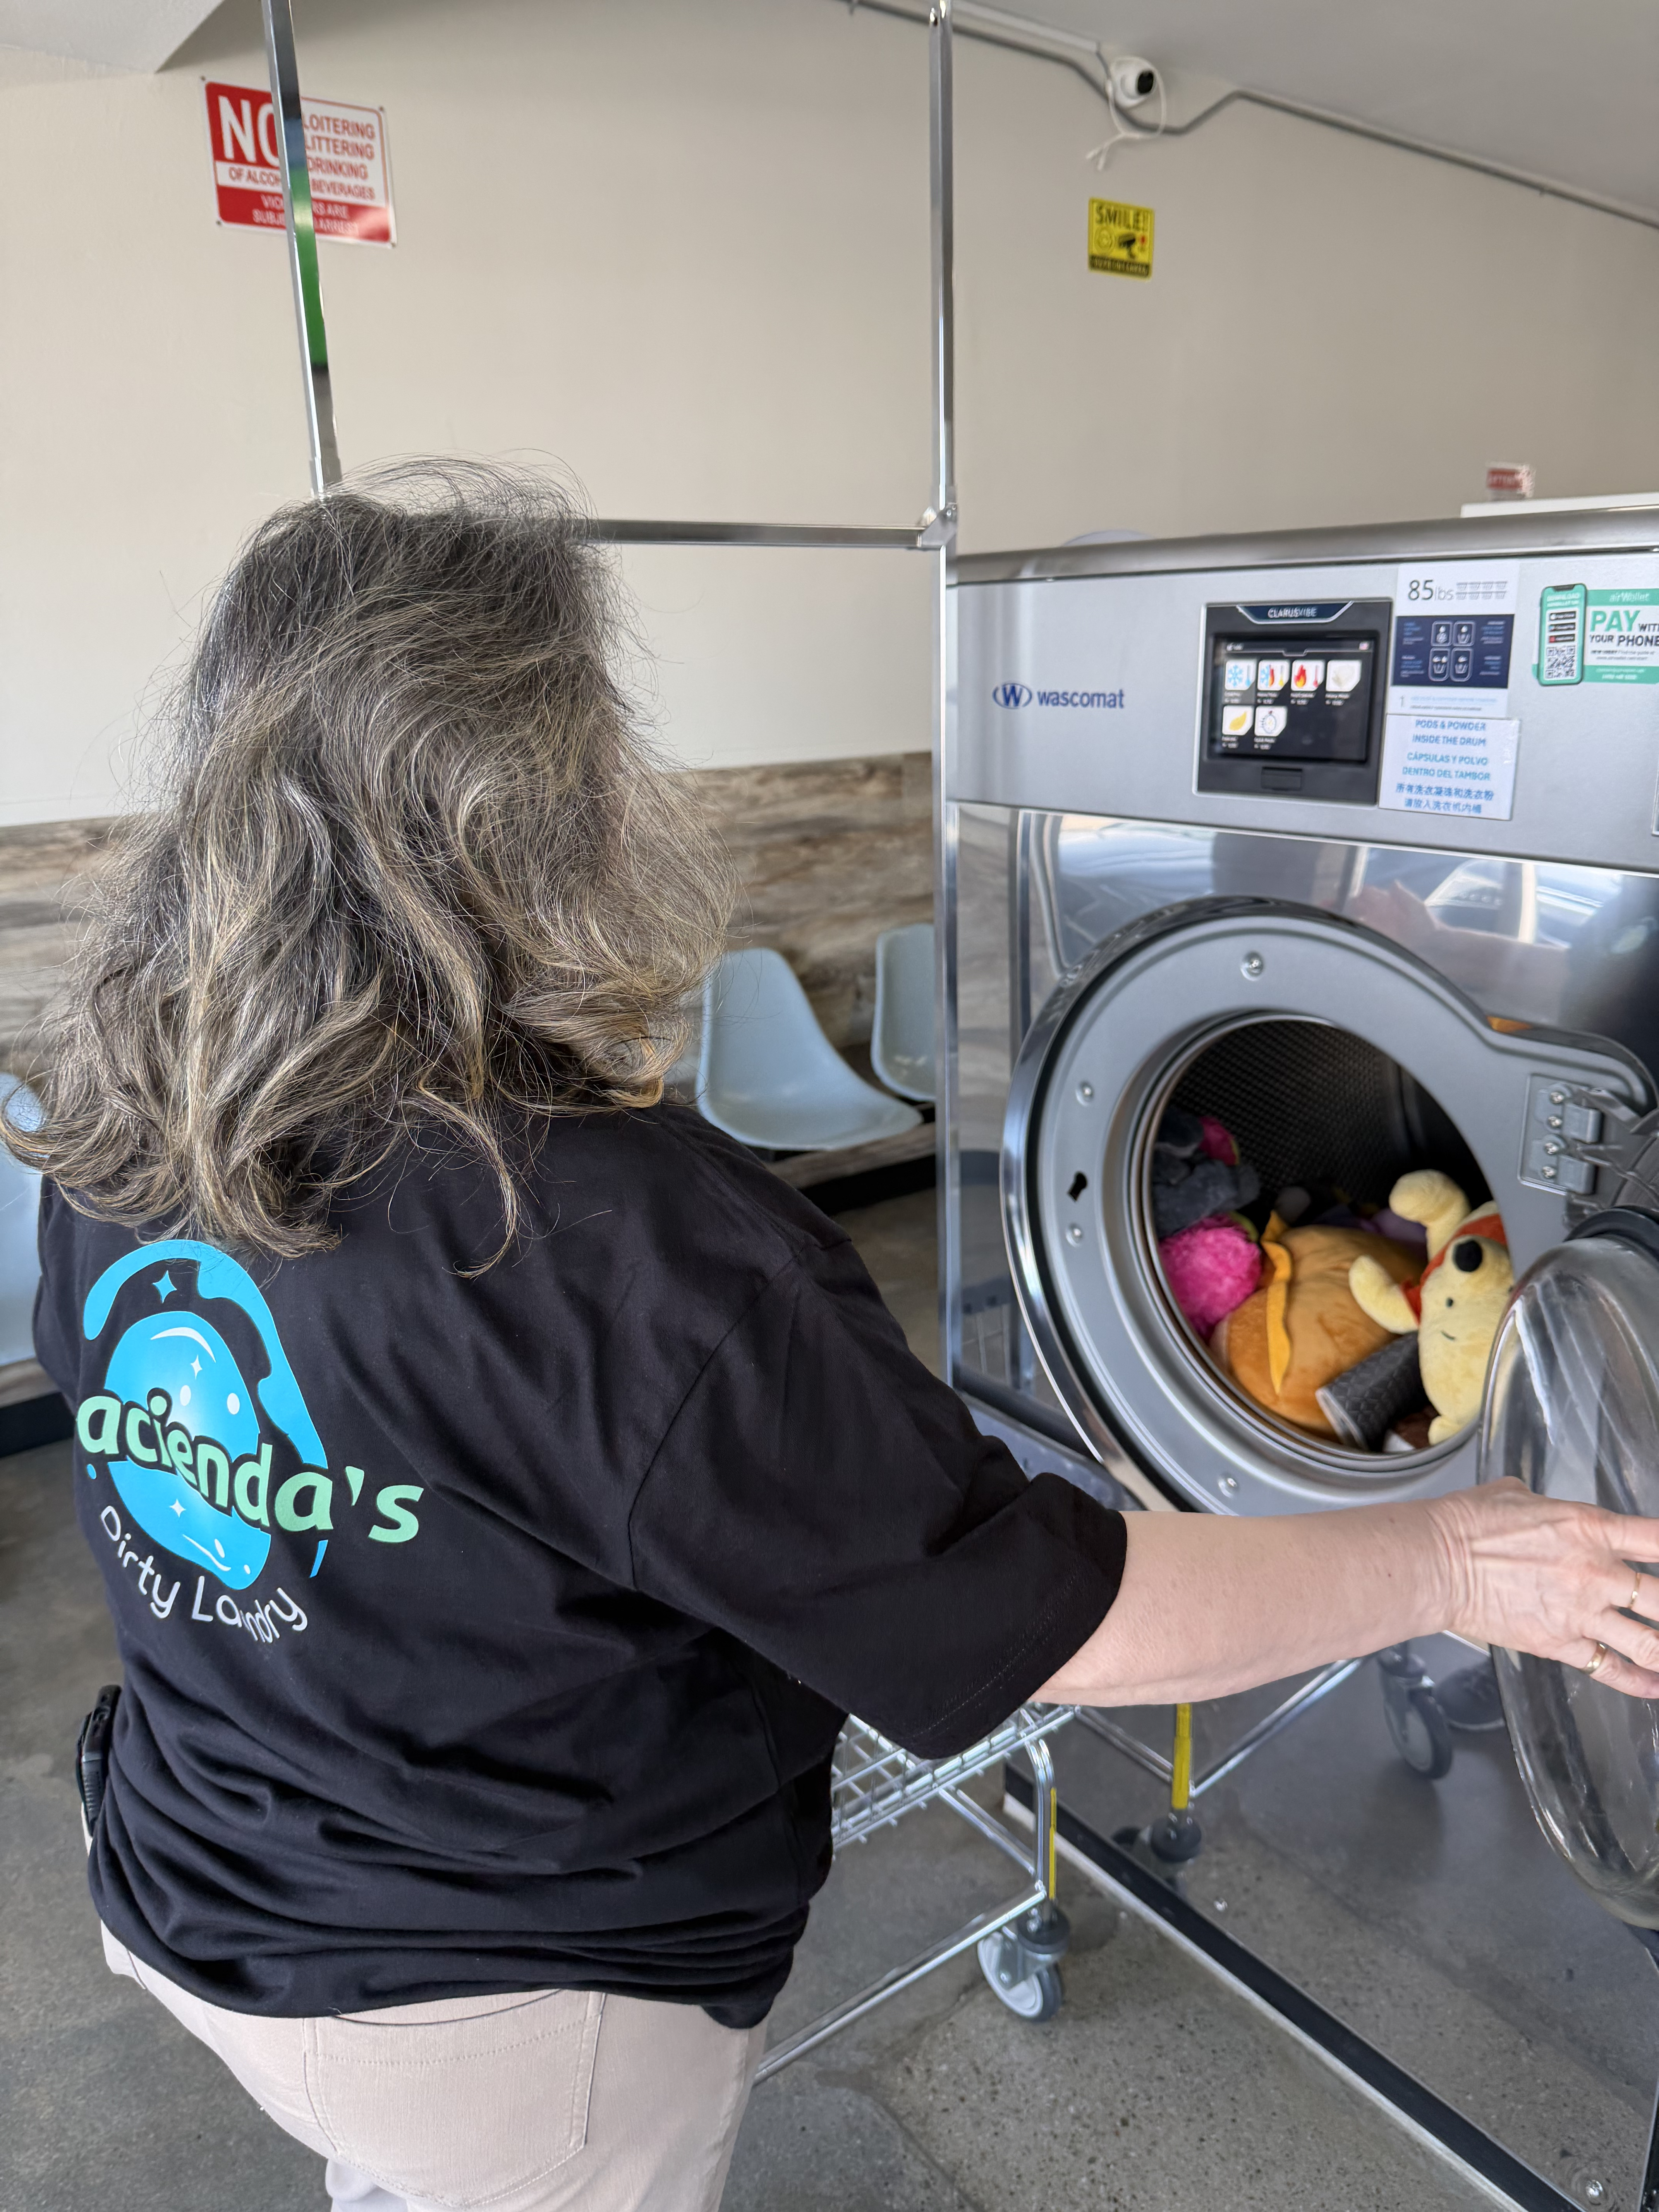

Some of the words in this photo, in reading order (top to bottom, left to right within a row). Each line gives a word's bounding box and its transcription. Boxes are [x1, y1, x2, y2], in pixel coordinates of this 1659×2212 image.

[303, 113, 376, 140] LOITERING
[304, 135, 375, 160] LITTERING
[307, 157, 368, 180] DRINKING
[228, 167, 243, 181] OF
[311, 179, 375, 200] BEVERAGES
[1590, 610, 1640, 632] PAY
[1638, 623, 1659, 632] WIT
[1590, 635, 1614, 643] YOUR
[1616, 635, 1659, 647] PHONE
[1037, 689, 1124, 709] wascomat
[1415, 720, 1438, 729] PODS
[1439, 721, 1445, 729] &
[1447, 721, 1486, 731] POWDER
[1412, 734, 1441, 744] INSIDE
[1442, 735, 1458, 745] THE
[1459, 737, 1486, 747] DRUM
[1407, 752, 1450, 763] CÁPSULAS
[1458, 756, 1488, 766] POLVO
[1402, 766, 1435, 776] DENTRO
[1436, 769, 1452, 778] DEL
[1455, 770, 1491, 781] TAMBOR
[101, 1506, 181, 1619] Dirty
